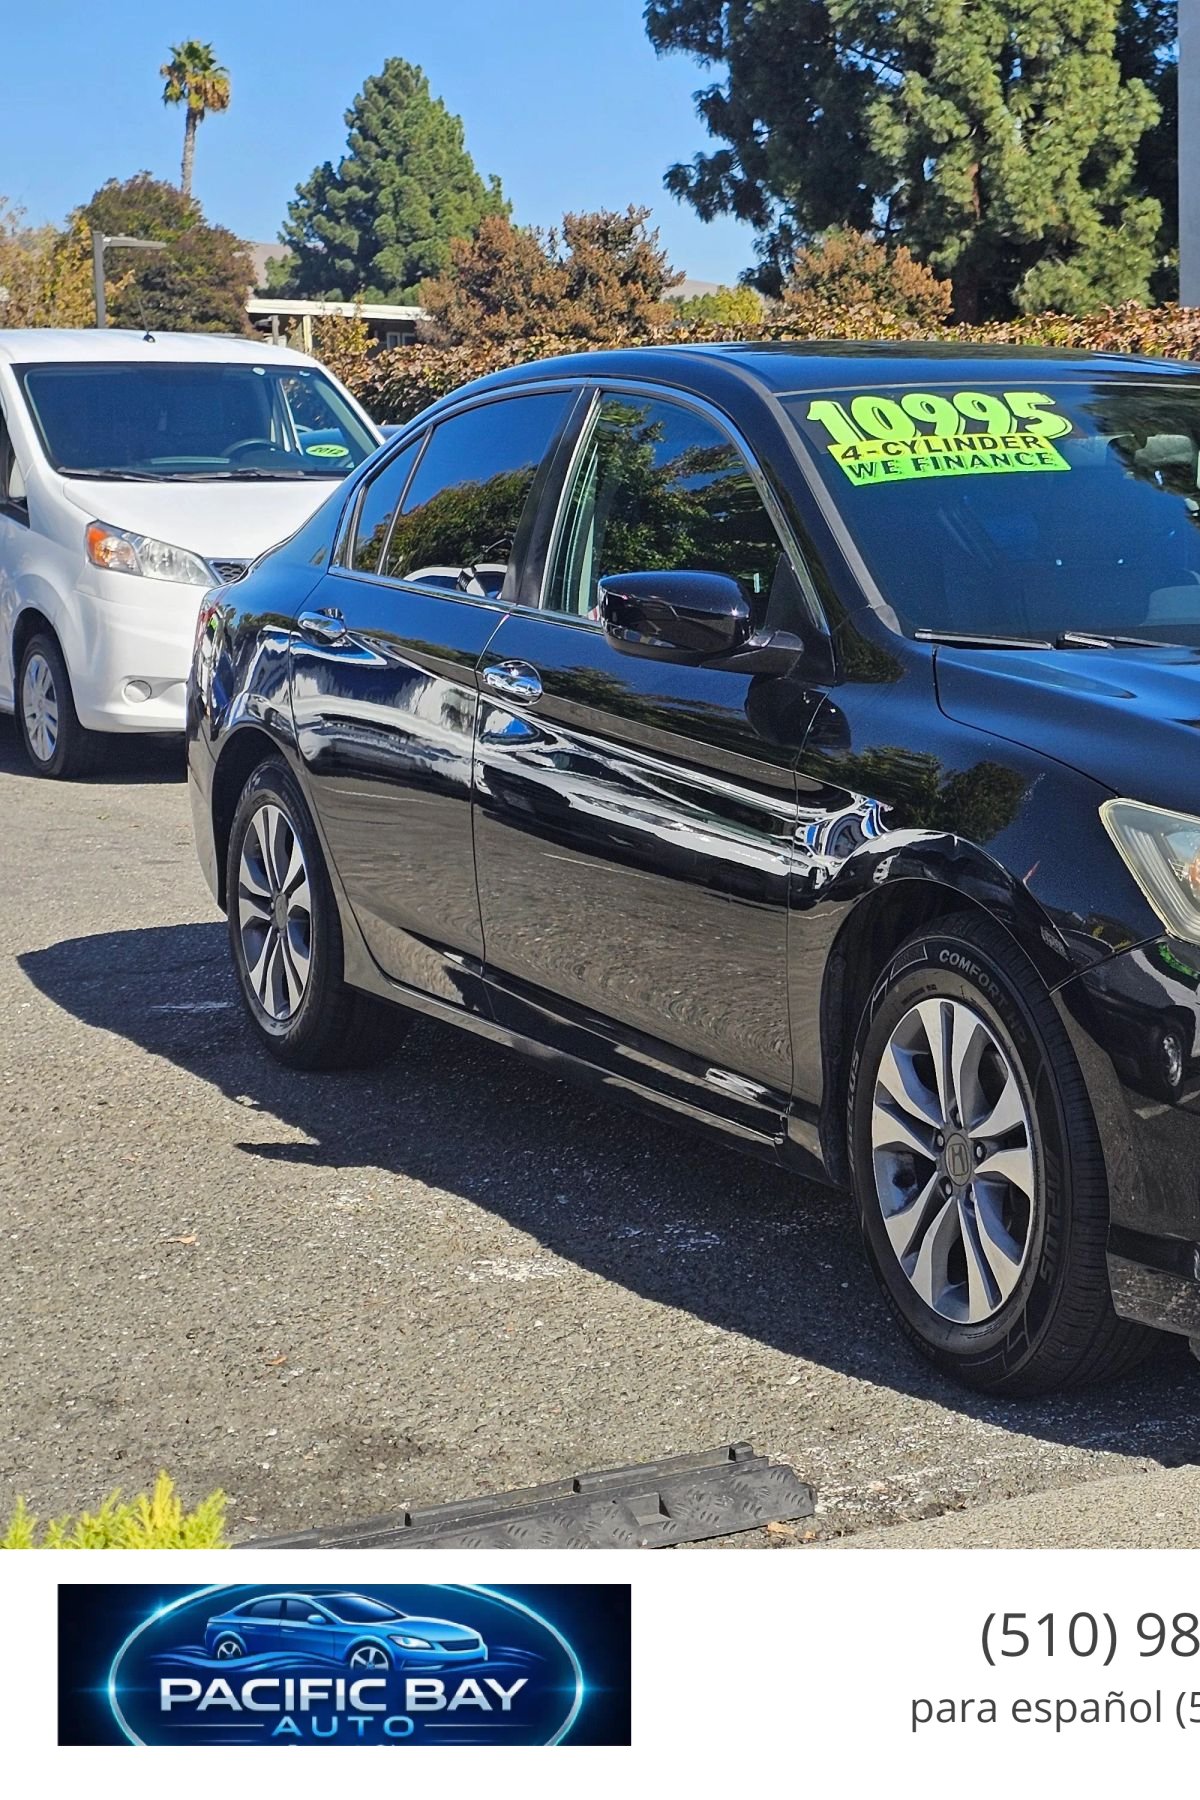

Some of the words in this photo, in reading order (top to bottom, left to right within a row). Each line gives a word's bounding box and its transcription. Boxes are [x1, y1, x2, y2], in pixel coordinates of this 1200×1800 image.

[807, 391, 1073, 443] 10995
[841, 435, 1046, 461] 4-CYLINDER
[848, 460, 901, 479] WE
[914, 451, 1058, 472] FINANCE
